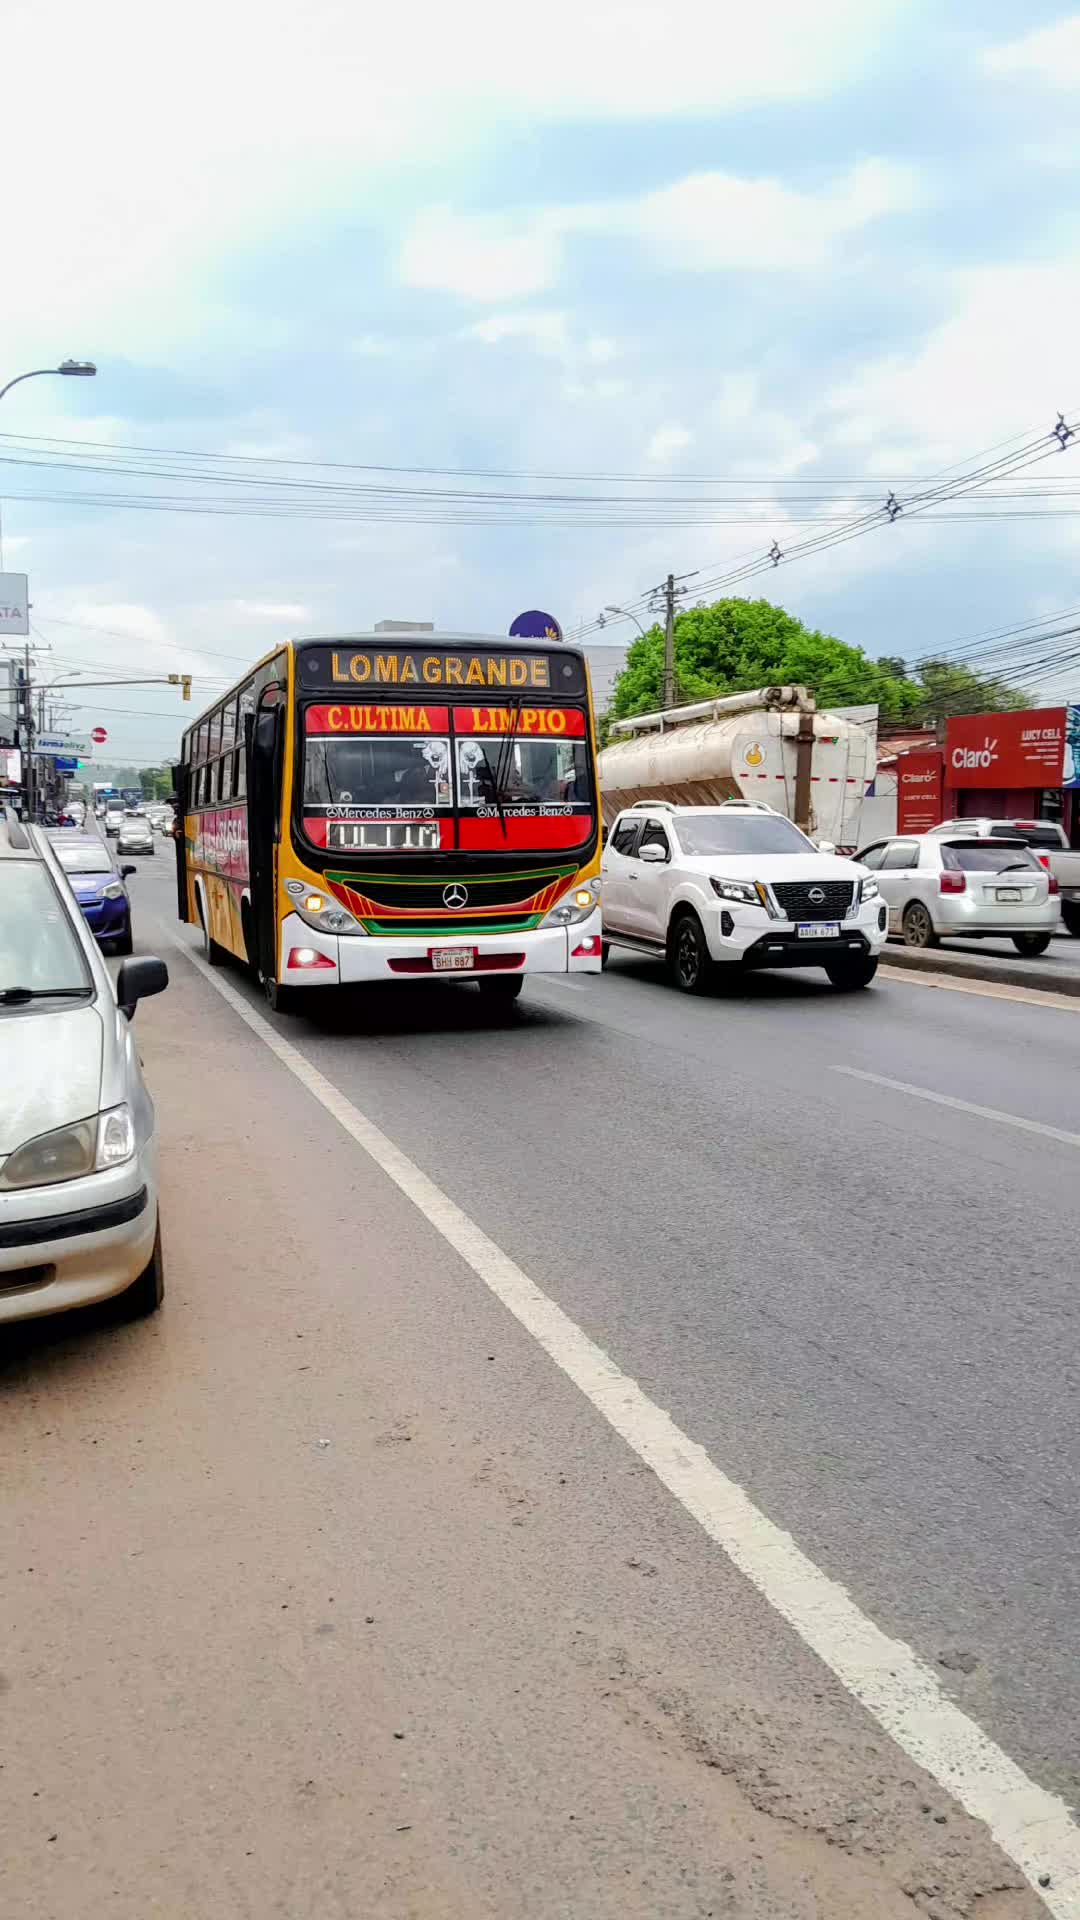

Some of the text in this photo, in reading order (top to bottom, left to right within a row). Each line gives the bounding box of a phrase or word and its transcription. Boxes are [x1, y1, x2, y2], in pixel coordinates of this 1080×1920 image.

[472, 707, 566, 733] LIMPIO
[1021, 727, 1062, 741] LUCY CELL
[952, 745, 993, 768] Claro
[901, 773, 934, 783] Claro
[337, 807, 422, 819] Mercedes-Benz
